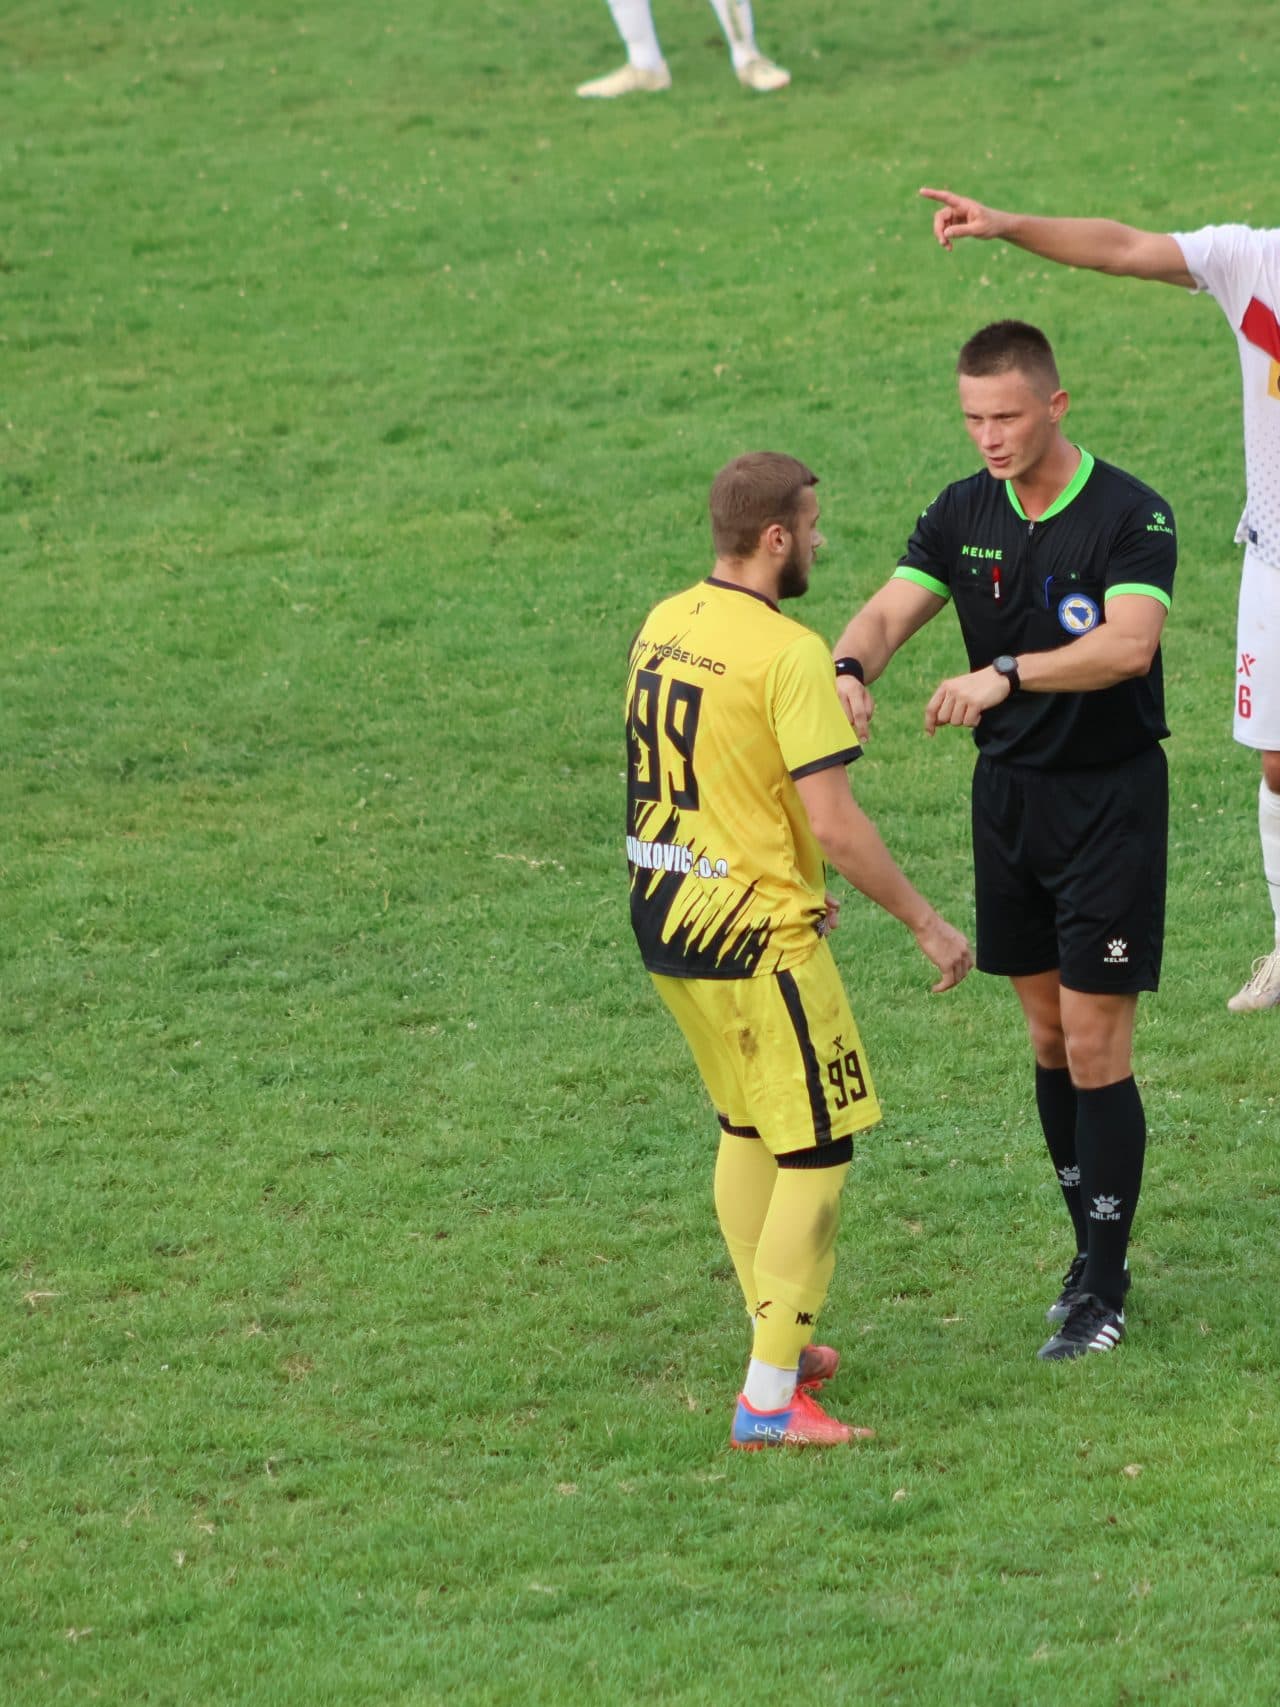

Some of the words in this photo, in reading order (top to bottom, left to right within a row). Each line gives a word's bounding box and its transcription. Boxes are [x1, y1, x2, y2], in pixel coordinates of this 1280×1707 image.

[962, 545, 1003, 560] KELME
[1237, 685, 1252, 720] 6
[630, 669, 704, 812] 99
[827, 1049, 868, 1111] 99
[1089, 1210, 1121, 1221] KELME
